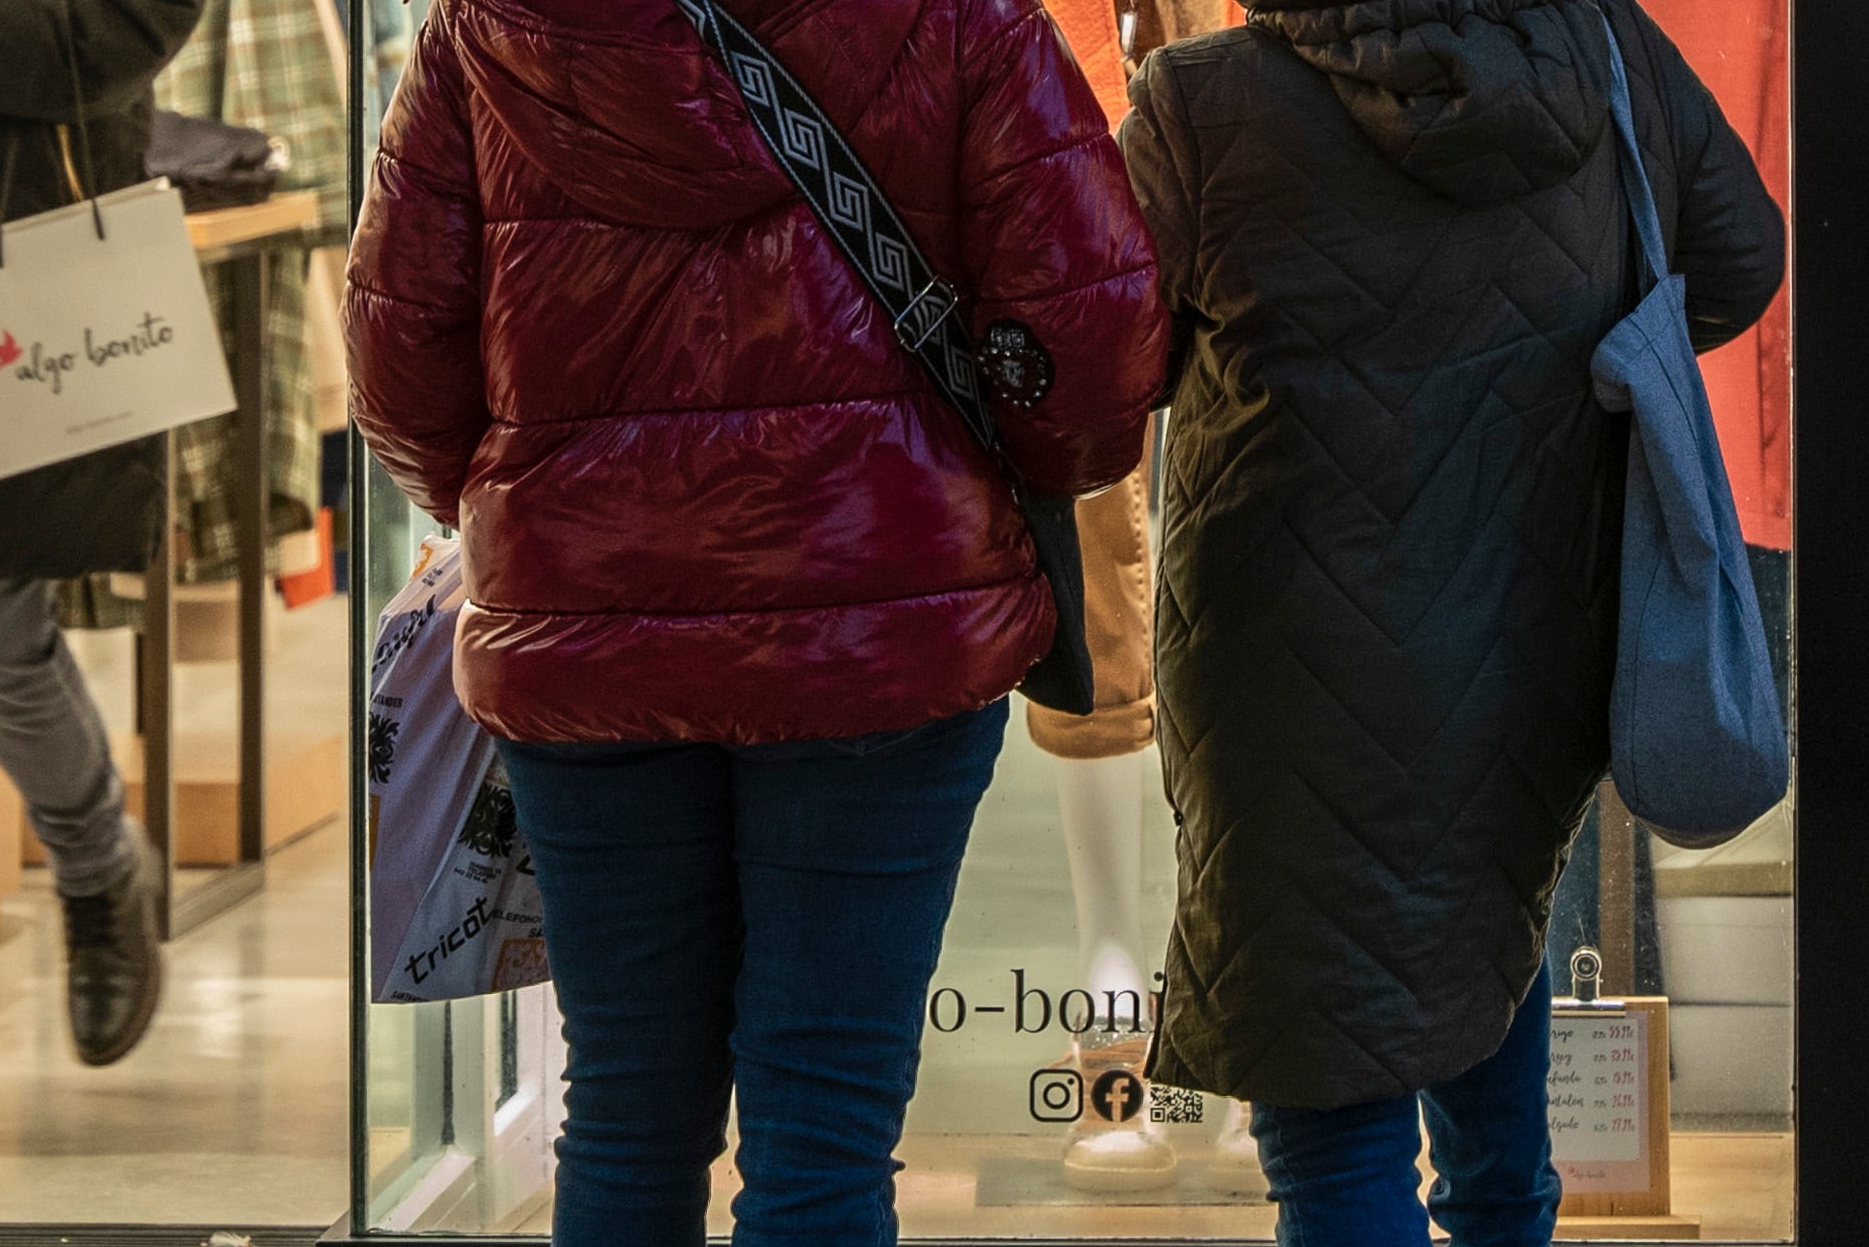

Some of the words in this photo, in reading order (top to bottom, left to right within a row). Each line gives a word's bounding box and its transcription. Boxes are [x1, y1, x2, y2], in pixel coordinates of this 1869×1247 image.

[16, 341, 75, 395] algo
[83, 311, 173, 367] bonito
[403, 896, 494, 985] tricot
